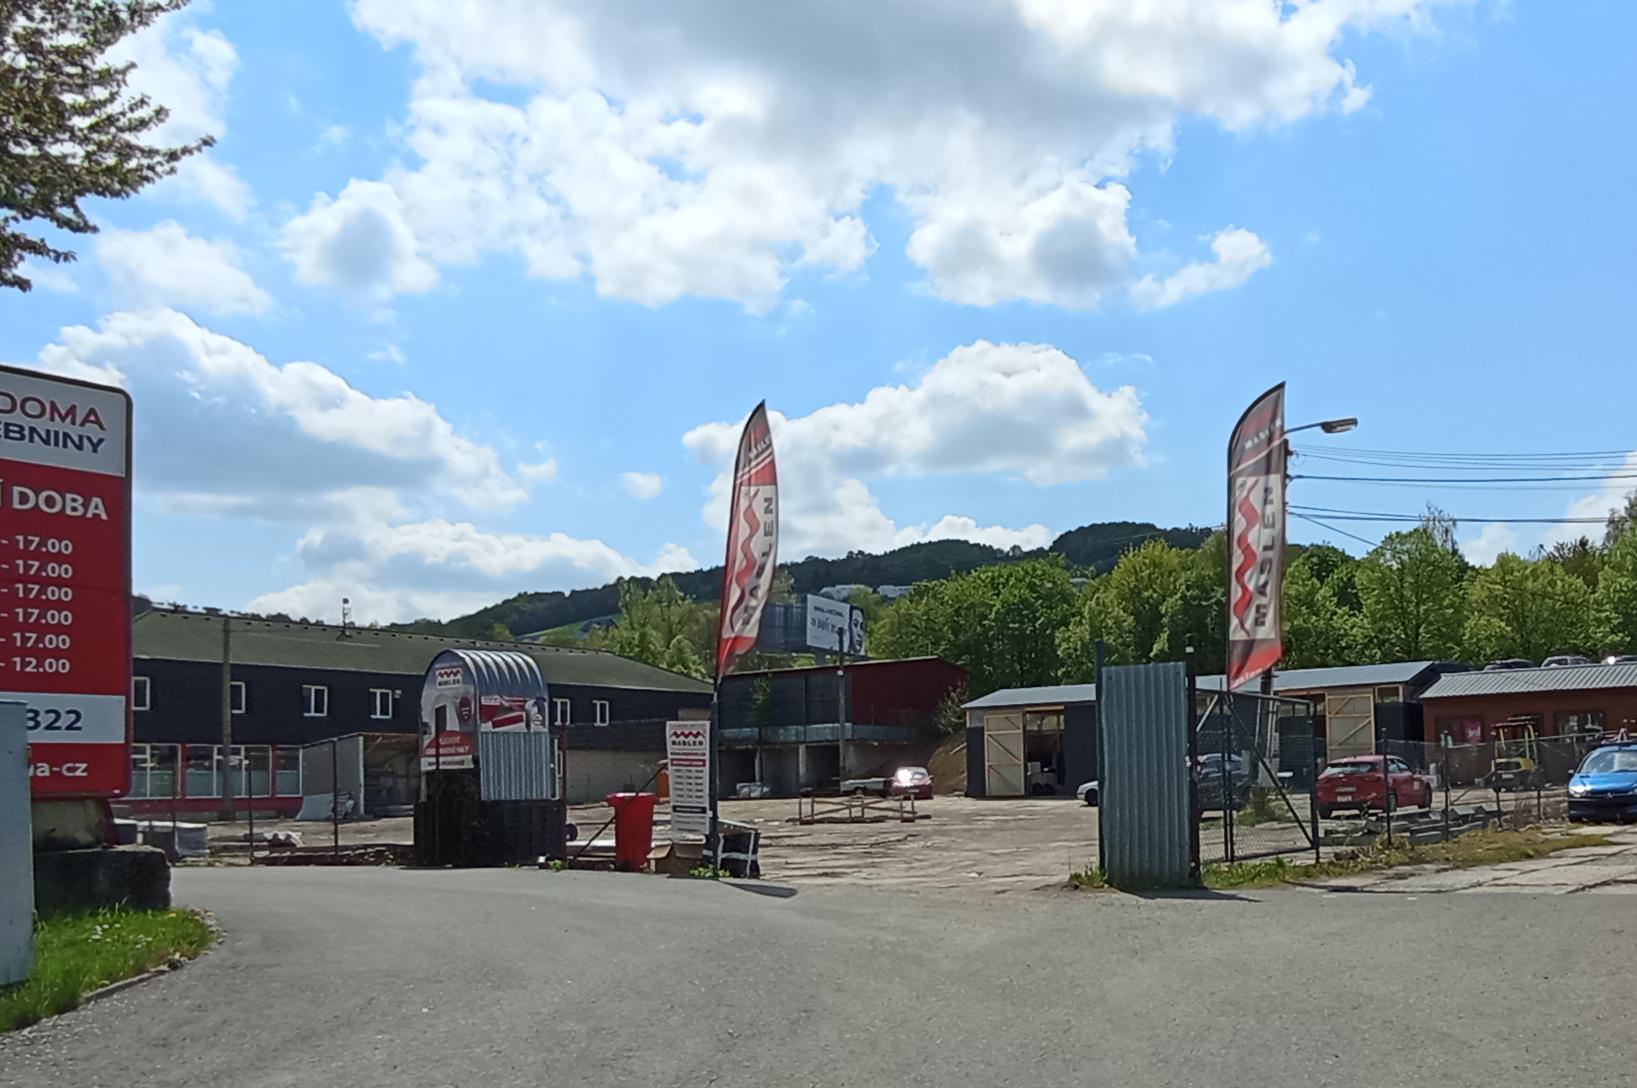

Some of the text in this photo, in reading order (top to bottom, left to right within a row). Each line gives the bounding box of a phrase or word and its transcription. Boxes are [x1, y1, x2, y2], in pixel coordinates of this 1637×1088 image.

[0, 391, 106, 431] DOMA
[0, 420, 106, 454] BNINY
[12, 485, 108, 520] DOBA
[15, 535, 73, 554] 17.00
[1254, 486, 1275, 627] MASLEN
[15, 559, 73, 578] 17.00
[14, 583, 73, 602] 17.00
[14, 608, 73, 625] 17.00
[12, 632, 70, 649] 17.00
[12, 657, 70, 673] 12.00
[26, 708, 83, 731] 322
